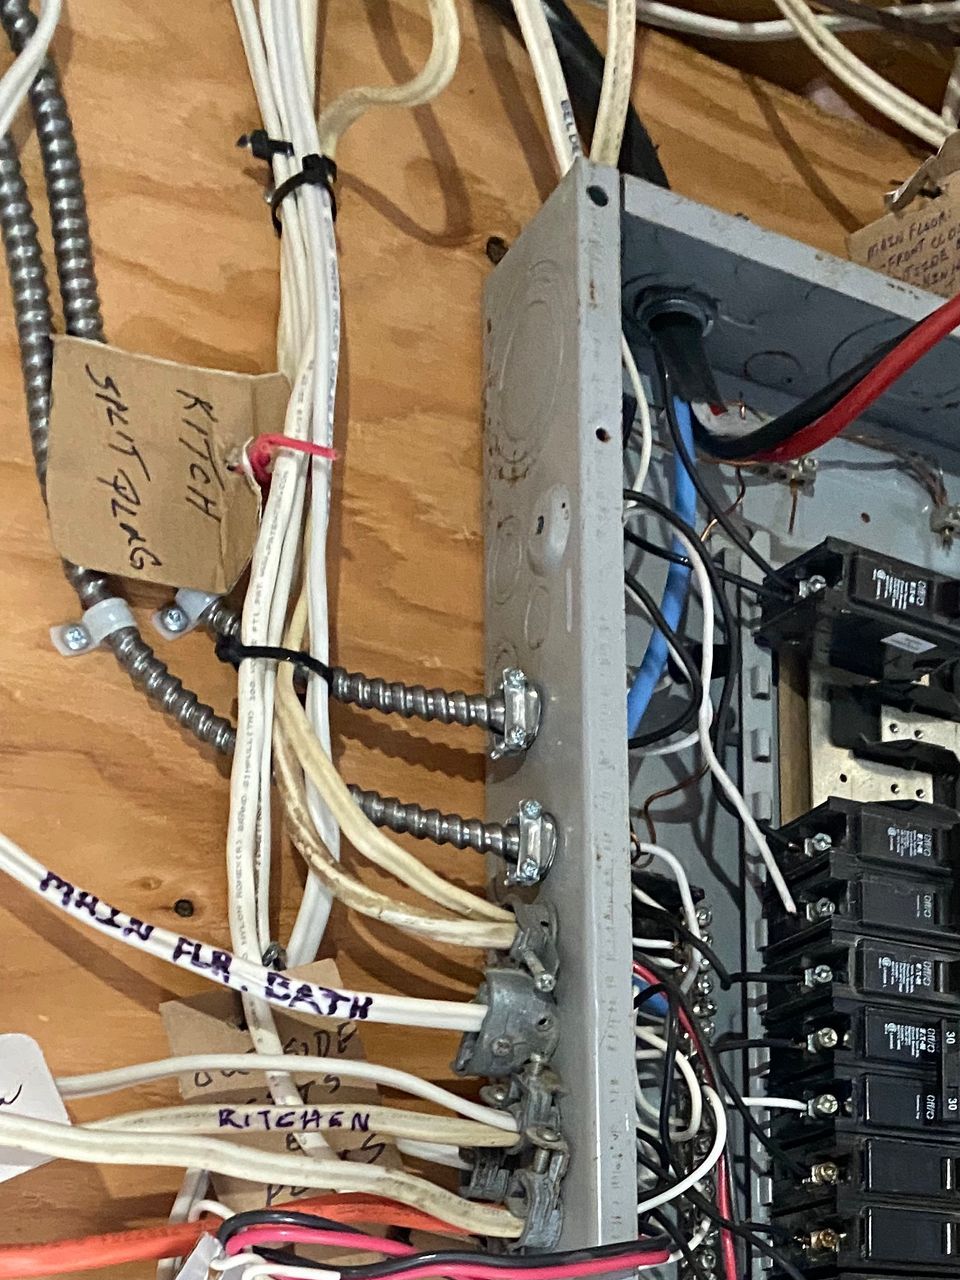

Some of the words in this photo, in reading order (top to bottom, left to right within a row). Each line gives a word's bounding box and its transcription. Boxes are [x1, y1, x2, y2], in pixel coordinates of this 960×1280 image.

[85, 363, 152, 483] SPLIT
[176, 388, 226, 522] KITCH
[97, 468, 162, 570] PLUG
[40, 870, 155, 941] MAIN
[265, 971, 374, 1020] BATH
[945, 1031, 956, 1045] 30
[947, 1097, 958, 1111] 30
